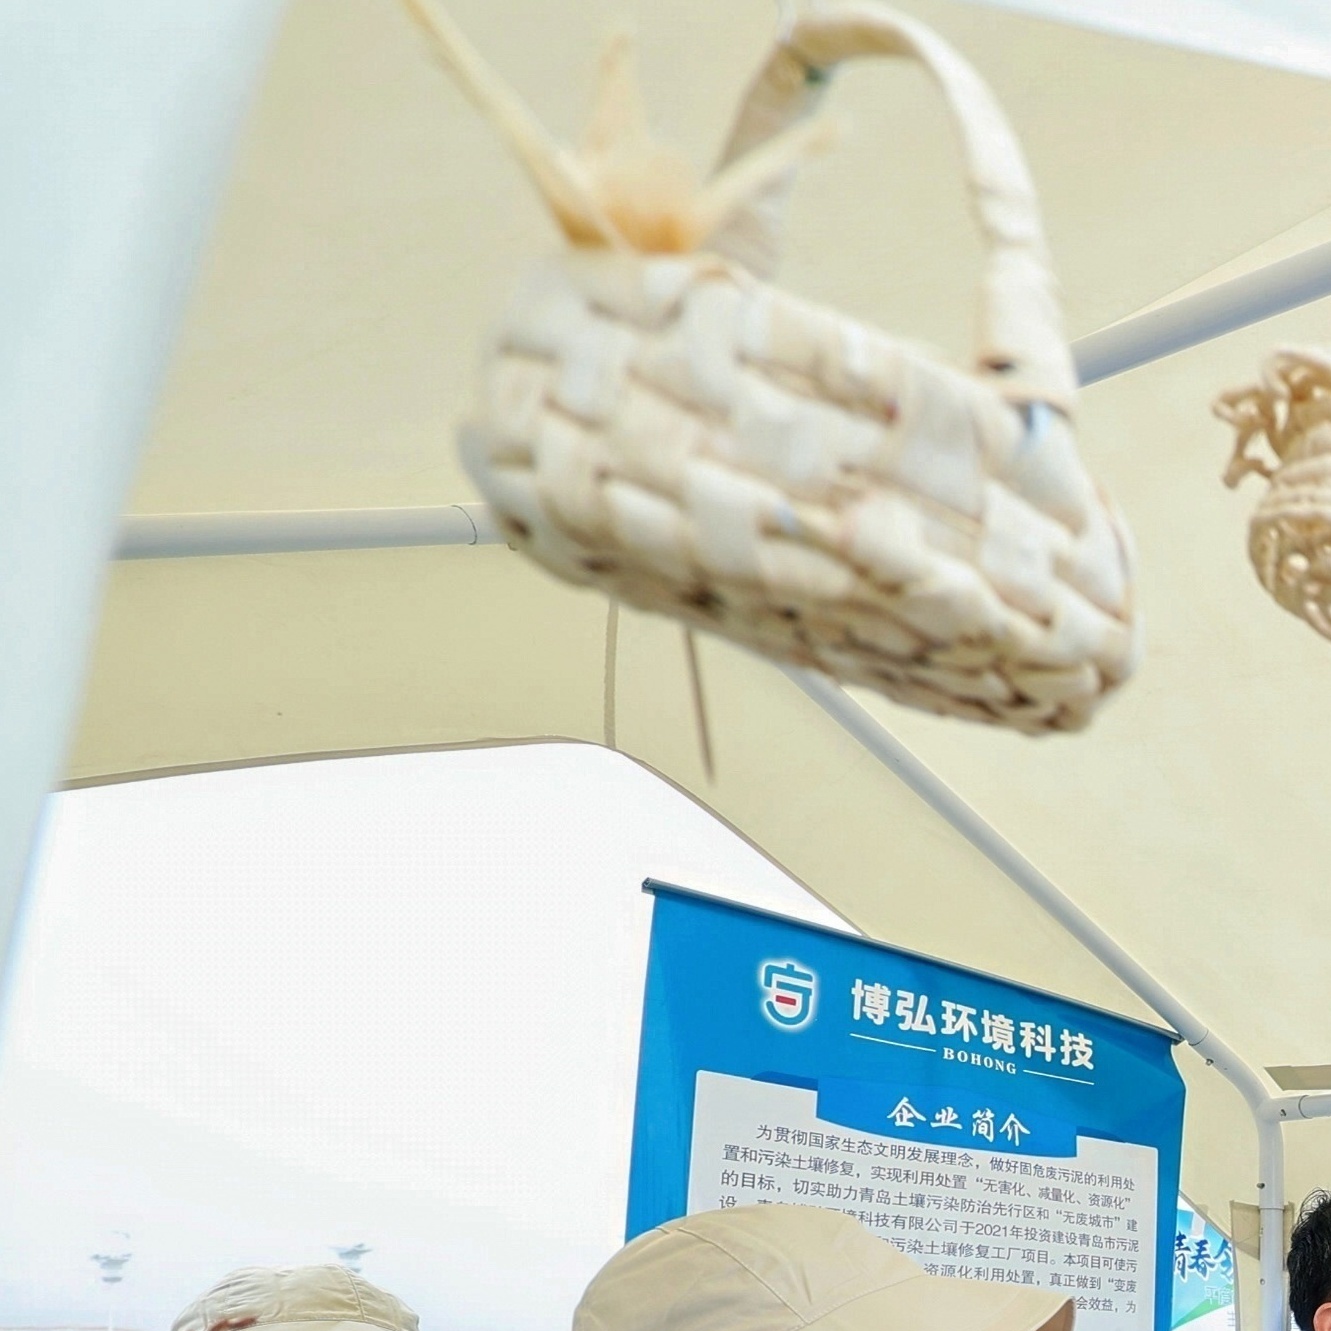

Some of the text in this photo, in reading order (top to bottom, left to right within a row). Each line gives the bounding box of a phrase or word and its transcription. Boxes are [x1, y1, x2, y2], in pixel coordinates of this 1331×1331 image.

[851, 978, 1094, 1070] 博弘环境科技
[942, 1047, 1017, 1075] BOHONG
[886, 1096, 1031, 1146] 企业简介
